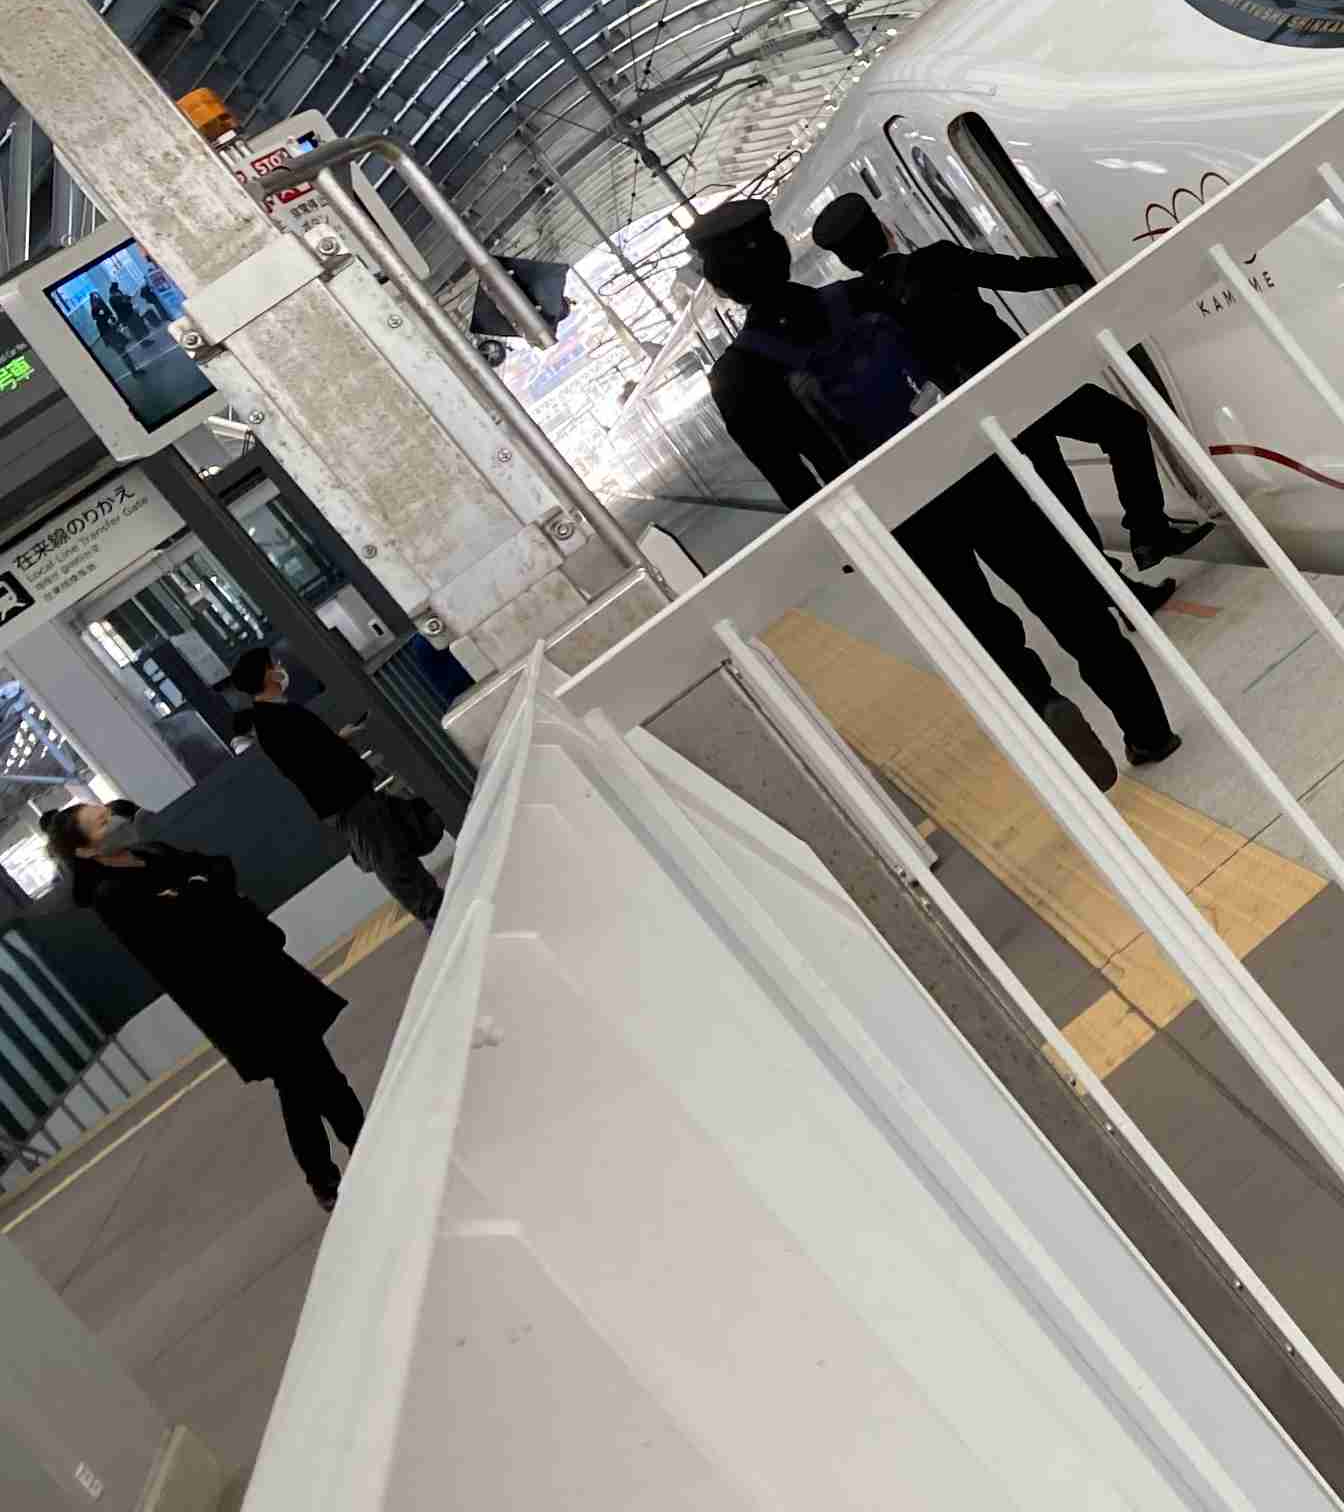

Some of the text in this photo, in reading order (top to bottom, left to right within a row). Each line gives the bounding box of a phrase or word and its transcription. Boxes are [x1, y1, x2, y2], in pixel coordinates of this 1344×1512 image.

[1196, 271, 1275, 318] KAMME
[13, 485, 135, 571] 在来線のりかえ
